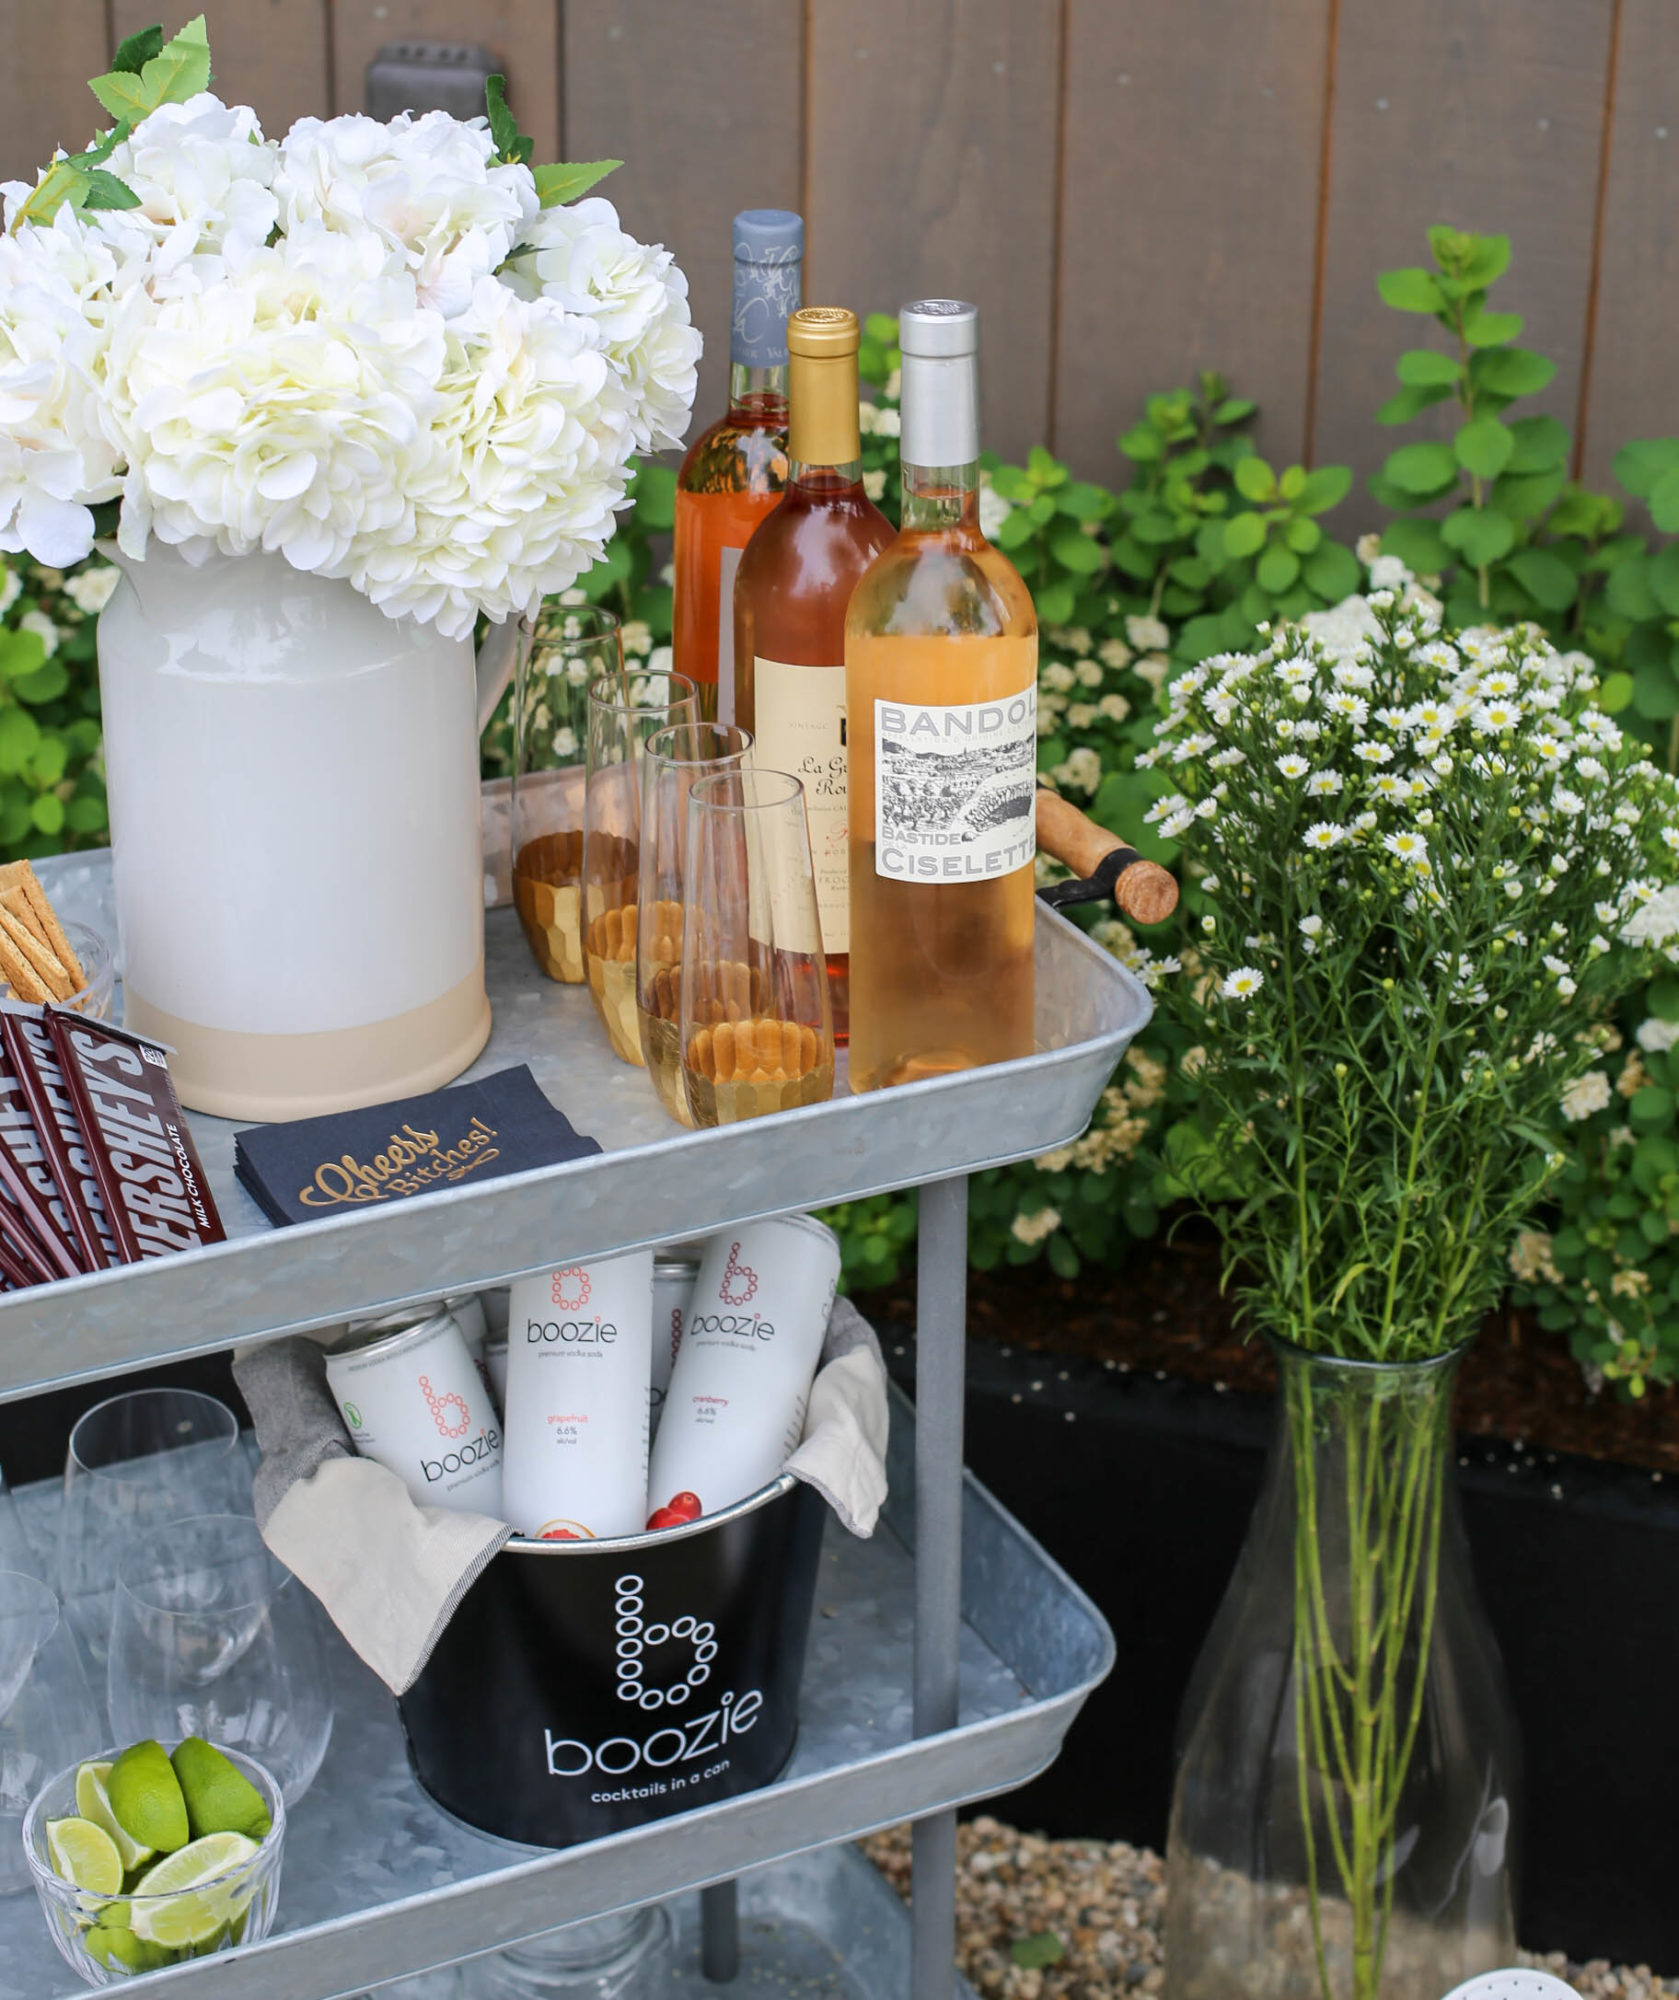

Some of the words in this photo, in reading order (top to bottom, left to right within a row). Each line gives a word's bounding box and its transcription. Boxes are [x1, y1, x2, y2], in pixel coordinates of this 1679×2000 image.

[881, 692, 1036, 736] BANDOL
[798, 756, 823, 774] La
[882, 825, 961, 846] BASTIDE
[166, 1122, 199, 1198] CHOCOLATE
[299, 1124, 440, 1207] Cheers
[384, 1116, 499, 1196] Bitches!
[194, 1199, 212, 1230] MILK
[527, 1315, 618, 1344] boozie
[690, 1312, 775, 1341] boozie
[547, 1413, 589, 1425] grapefruit
[556, 1426, 578, 1436] 6.6%
[420, 1428, 499, 1483] boozie
[544, 1690, 764, 1777] boozie
[591, 1782, 667, 1803] cocktails
[671, 1778, 687, 1791] in
[690, 1773, 701, 1784] a
[703, 1759, 731, 1778] can
